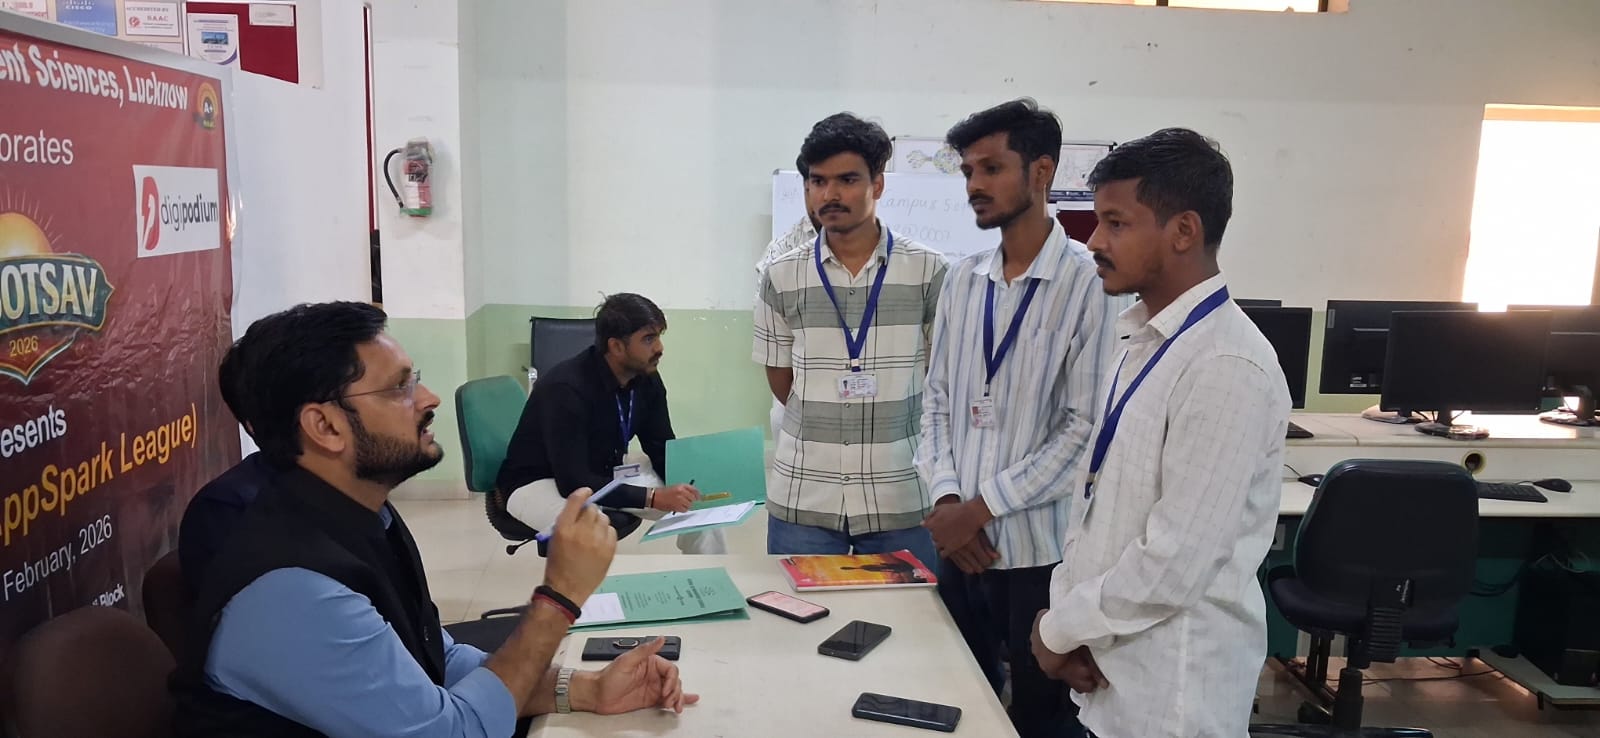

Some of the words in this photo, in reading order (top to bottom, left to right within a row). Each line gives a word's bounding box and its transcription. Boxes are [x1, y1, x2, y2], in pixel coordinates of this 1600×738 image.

[28, 44, 124, 109] Sciences,
[123, 65, 189, 110] Lucknow
[0, 129, 74, 166] orates
[160, 193, 219, 231] digipodium
[0, 262, 98, 320] OTSAV
[9, 335, 39, 357] 2026
[0, 404, 68, 459] esents
[0, 441, 114, 546] ppSpark
[120, 402, 198, 474] League)
[3, 541, 77, 602] February,
[79, 514, 114, 555] 2026
